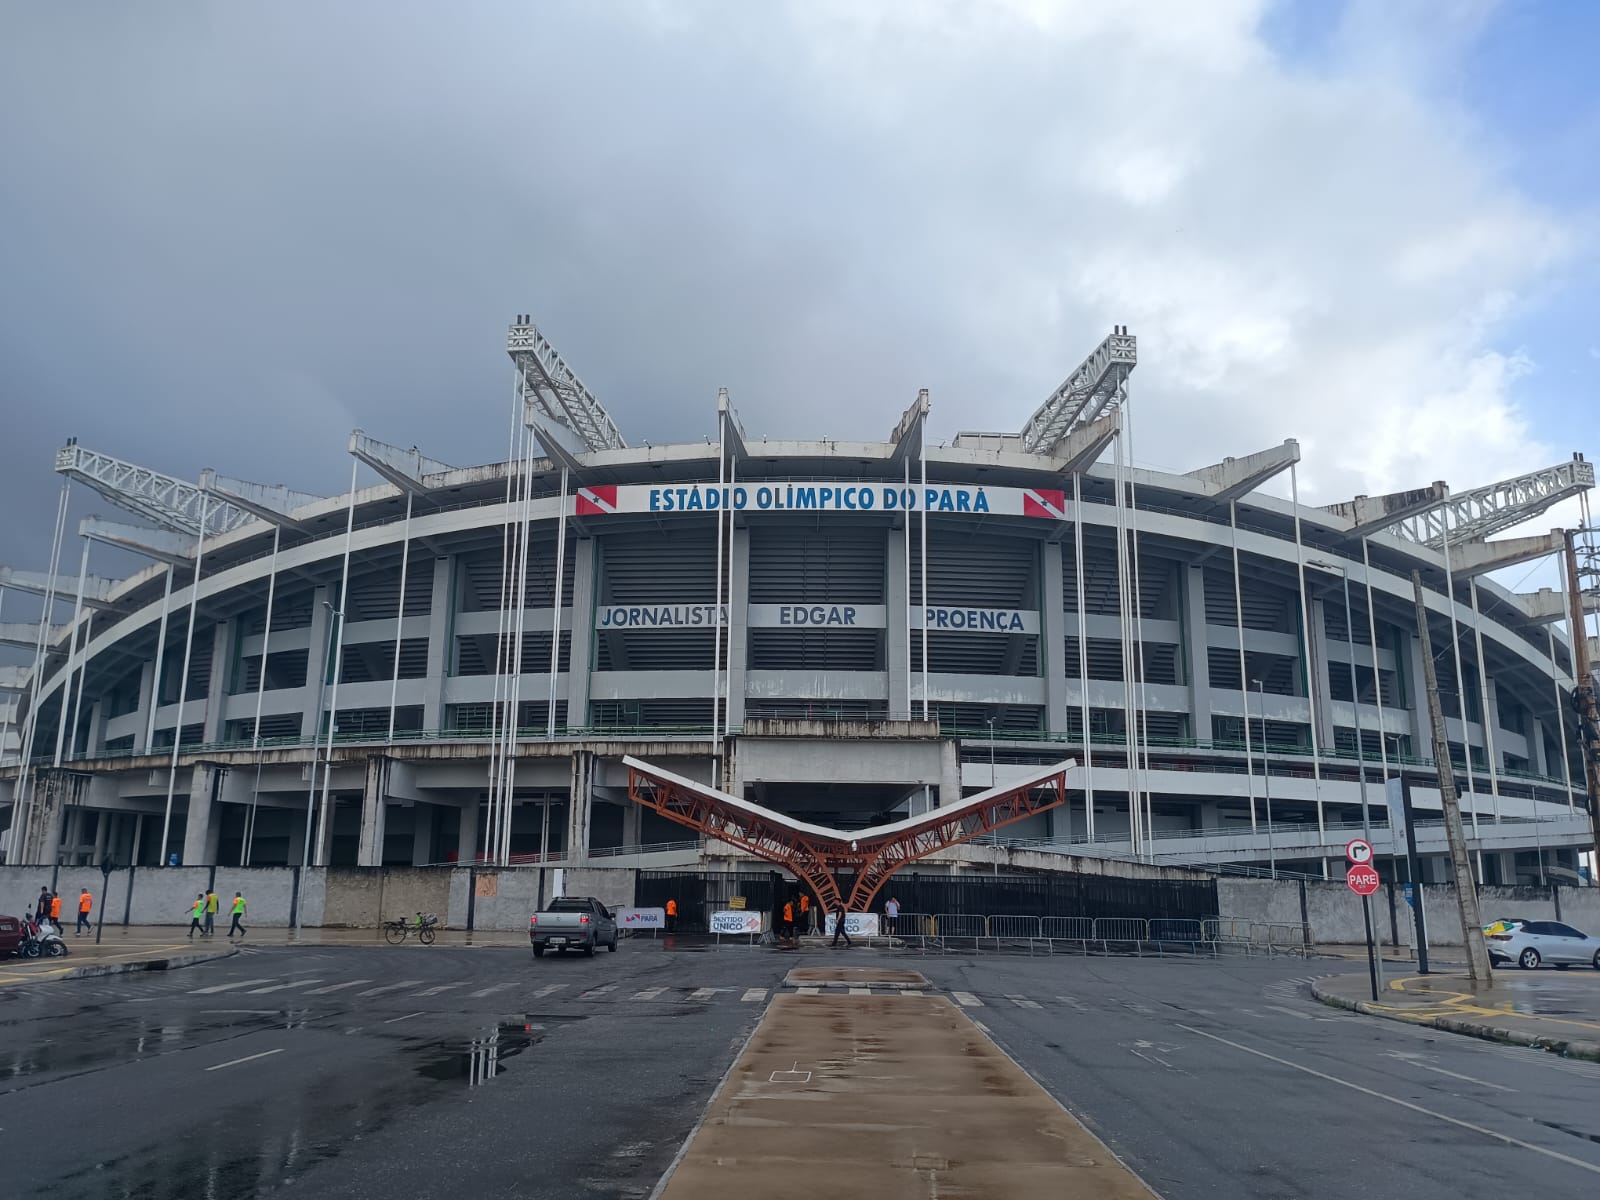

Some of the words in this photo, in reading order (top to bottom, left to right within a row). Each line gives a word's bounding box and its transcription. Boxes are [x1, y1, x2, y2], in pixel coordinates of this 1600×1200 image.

[883, 487, 916, 510] DO
[601, 606, 729, 626] JORNALISTA
[780, 606, 856, 625] EDGAR
[926, 608, 1025, 632] PROENÇA
[1350, 874, 1377, 885] PARE
